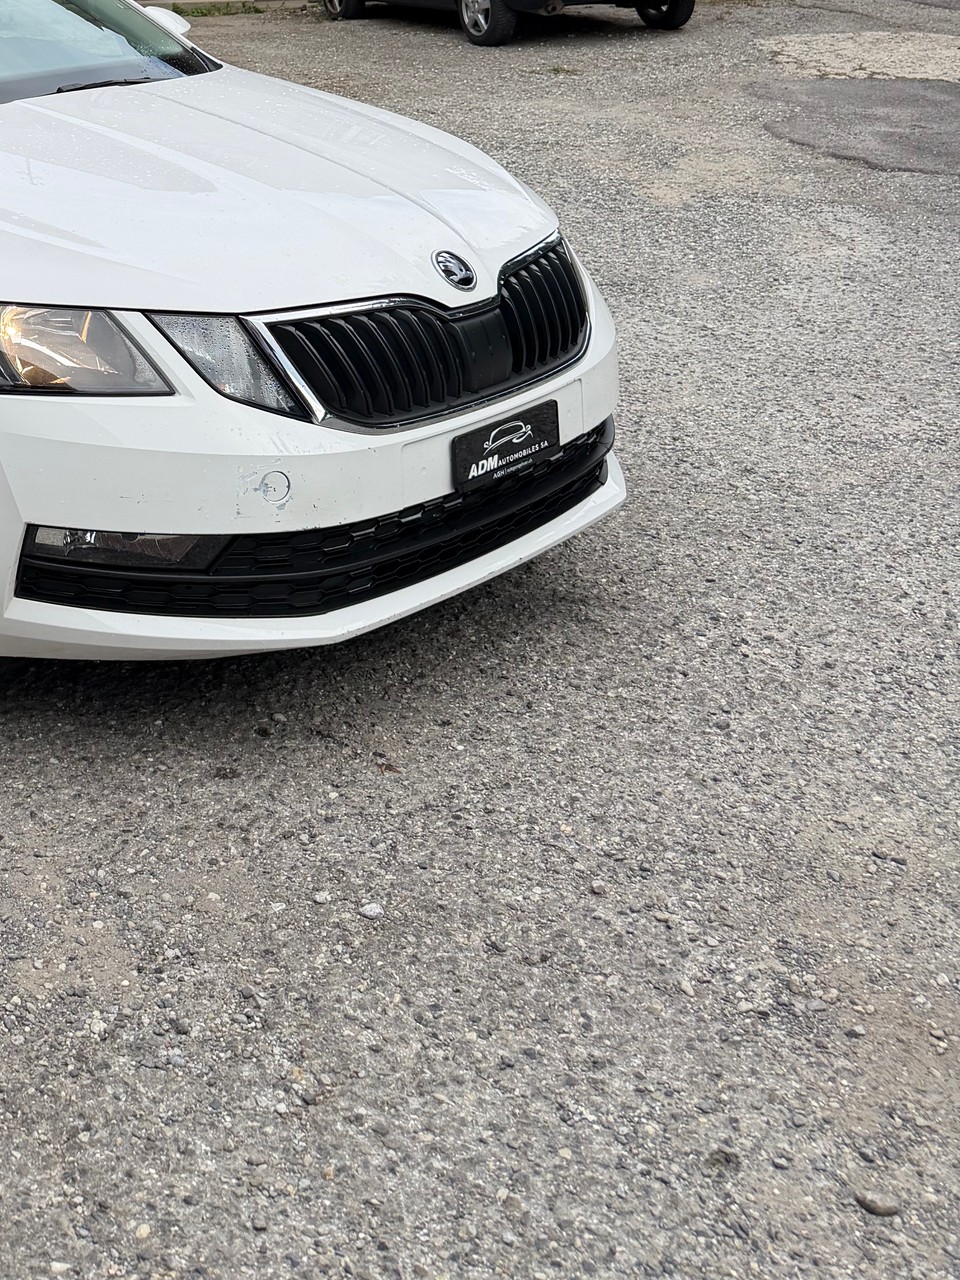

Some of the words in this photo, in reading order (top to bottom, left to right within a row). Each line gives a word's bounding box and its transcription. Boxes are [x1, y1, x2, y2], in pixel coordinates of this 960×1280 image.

[468, 454, 498, 480] ADM
[498, 444, 539, 467] AUTOMOBILES
[540, 440, 548, 448] SA
